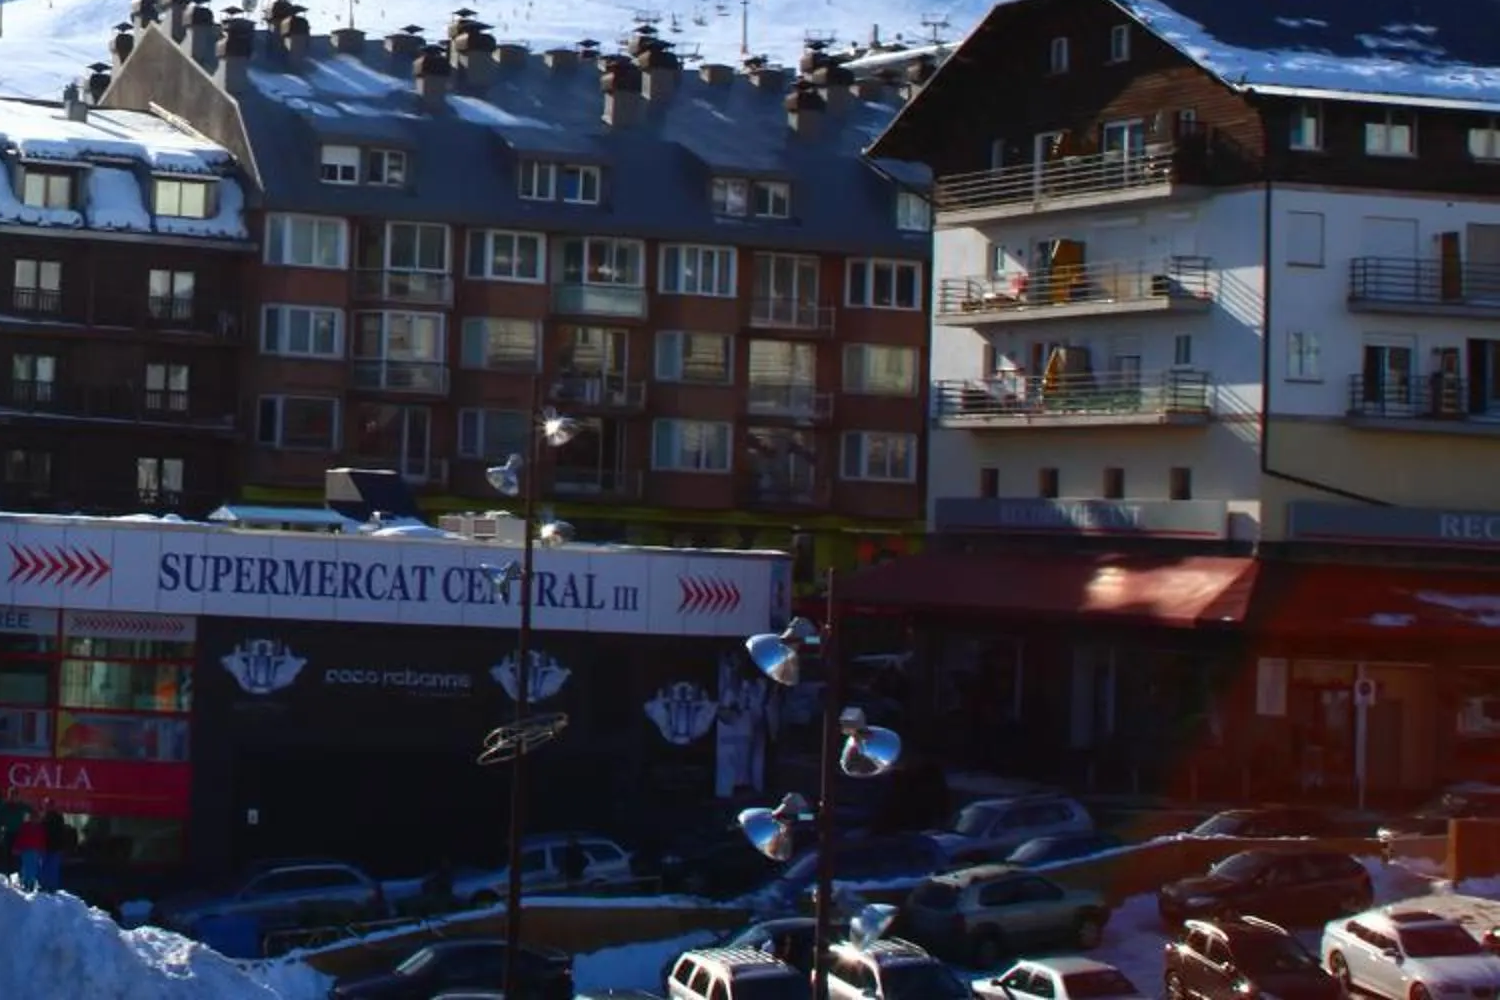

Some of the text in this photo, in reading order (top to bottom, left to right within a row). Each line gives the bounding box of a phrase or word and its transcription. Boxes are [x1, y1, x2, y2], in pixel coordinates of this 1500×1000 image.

[158, 552, 435, 602] SUPERMERCAT
[611, 584, 639, 612] III
[7, 761, 95, 791] GALA
